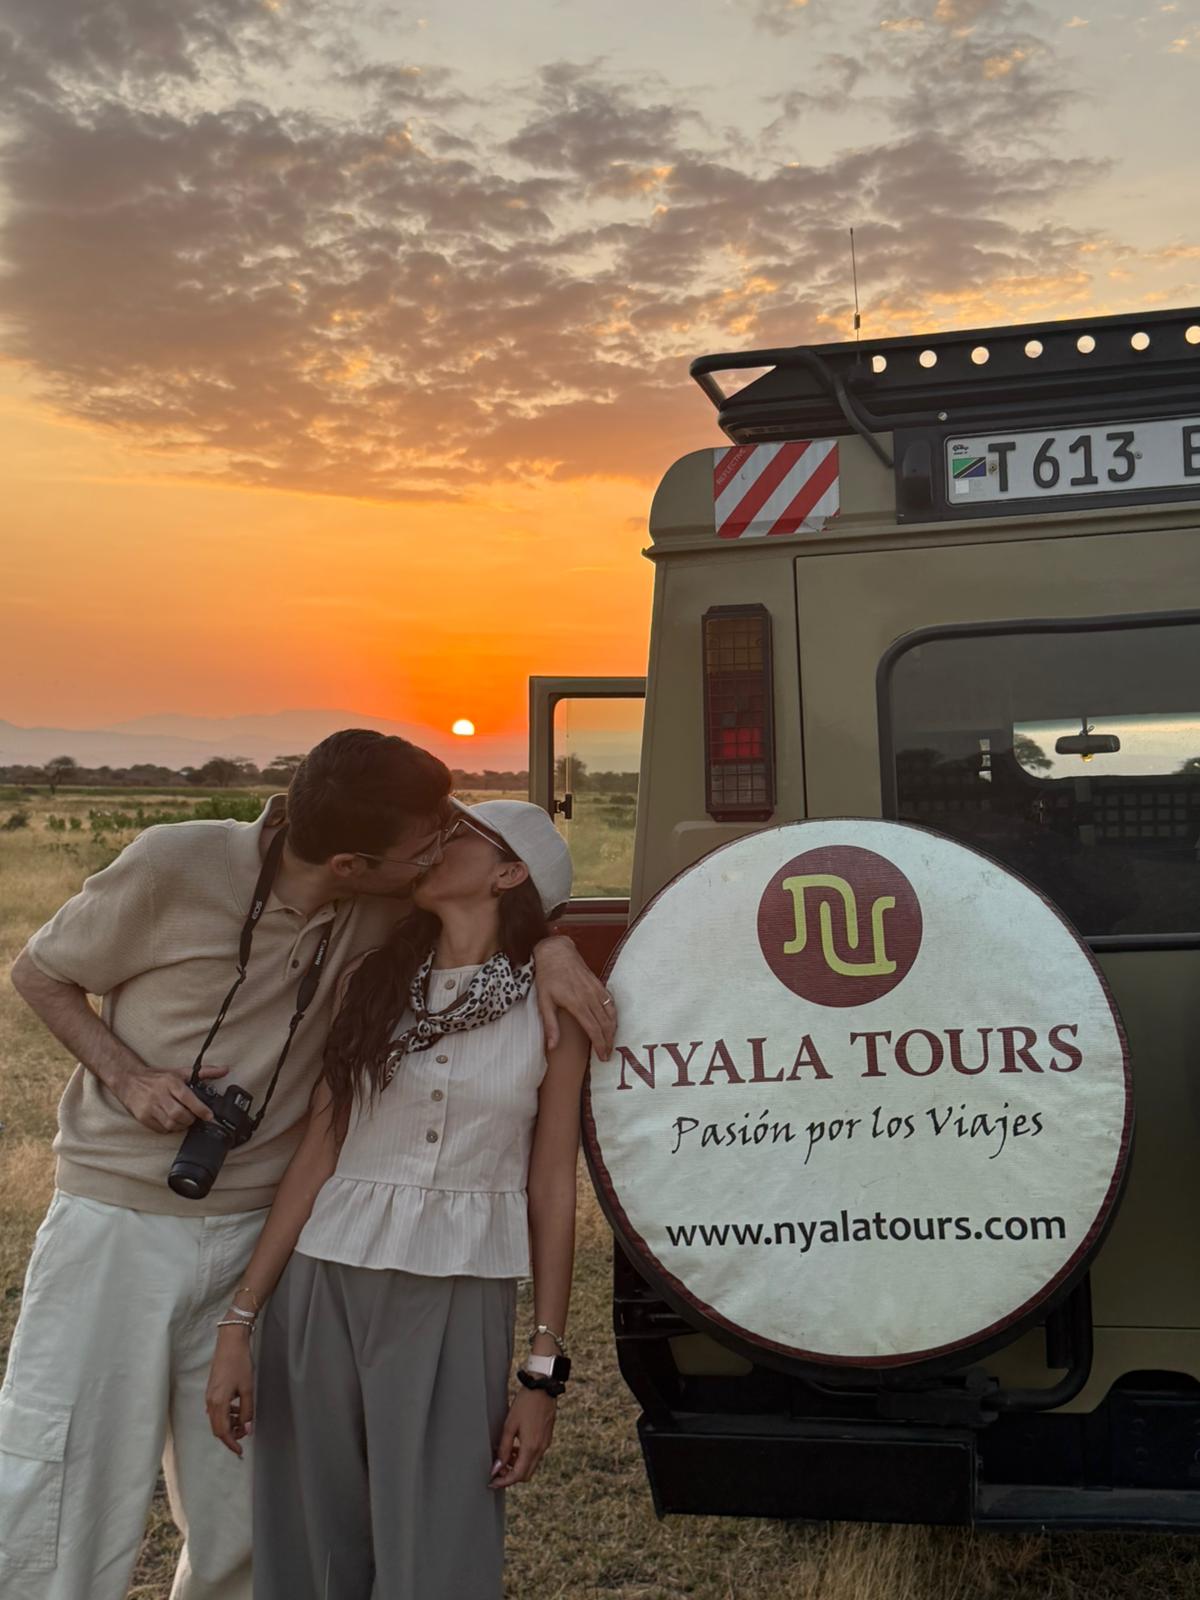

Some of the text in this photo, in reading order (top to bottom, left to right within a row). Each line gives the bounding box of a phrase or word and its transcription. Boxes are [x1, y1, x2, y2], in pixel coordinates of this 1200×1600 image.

[988, 441, 1016, 492] T
[1033, 431, 1136, 489] 613
[615, 1023, 1084, 1091] NYALA TOURS
[671, 1102, 1044, 1165] Pasión por los Viajes
[665, 1209, 1067, 1253] www.nyalatours.com
